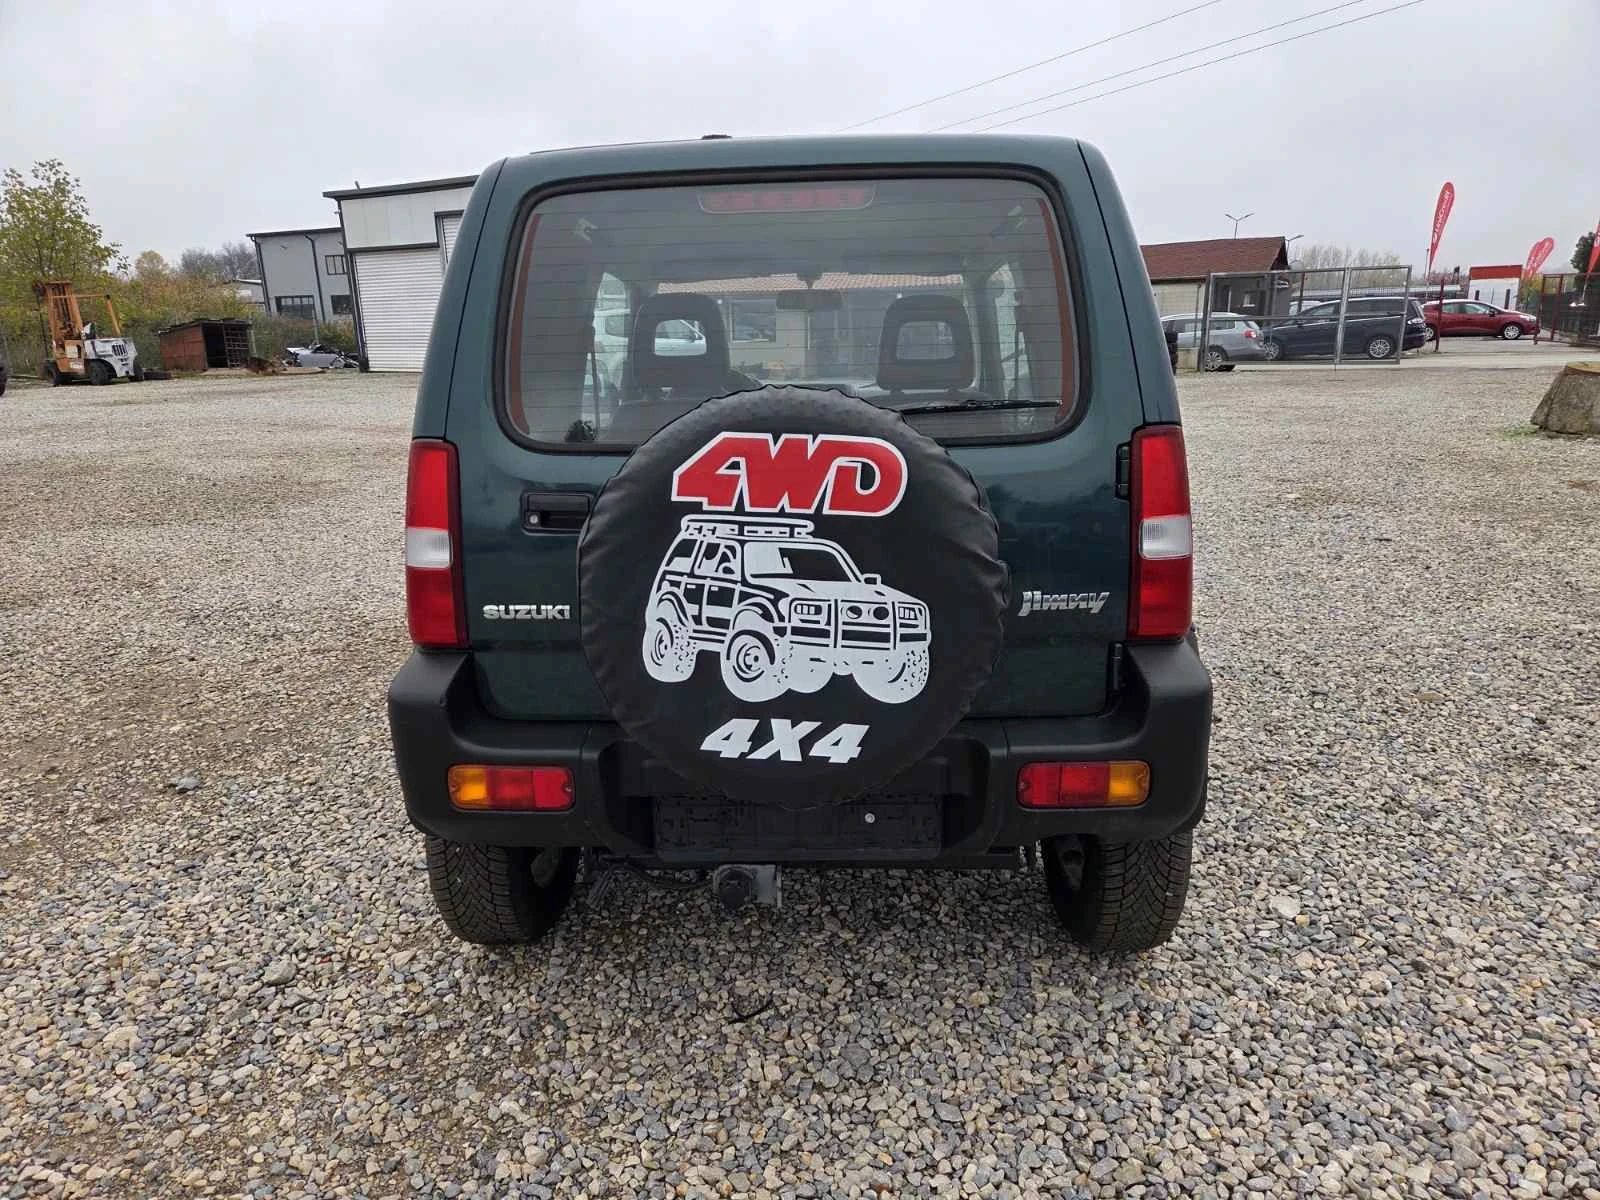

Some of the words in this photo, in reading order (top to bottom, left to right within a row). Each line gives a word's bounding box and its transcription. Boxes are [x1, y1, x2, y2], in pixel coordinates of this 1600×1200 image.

[671, 432, 908, 517] 4WD
[482, 604, 570, 620] SUZUKI
[700, 718, 870, 764] 4X4
